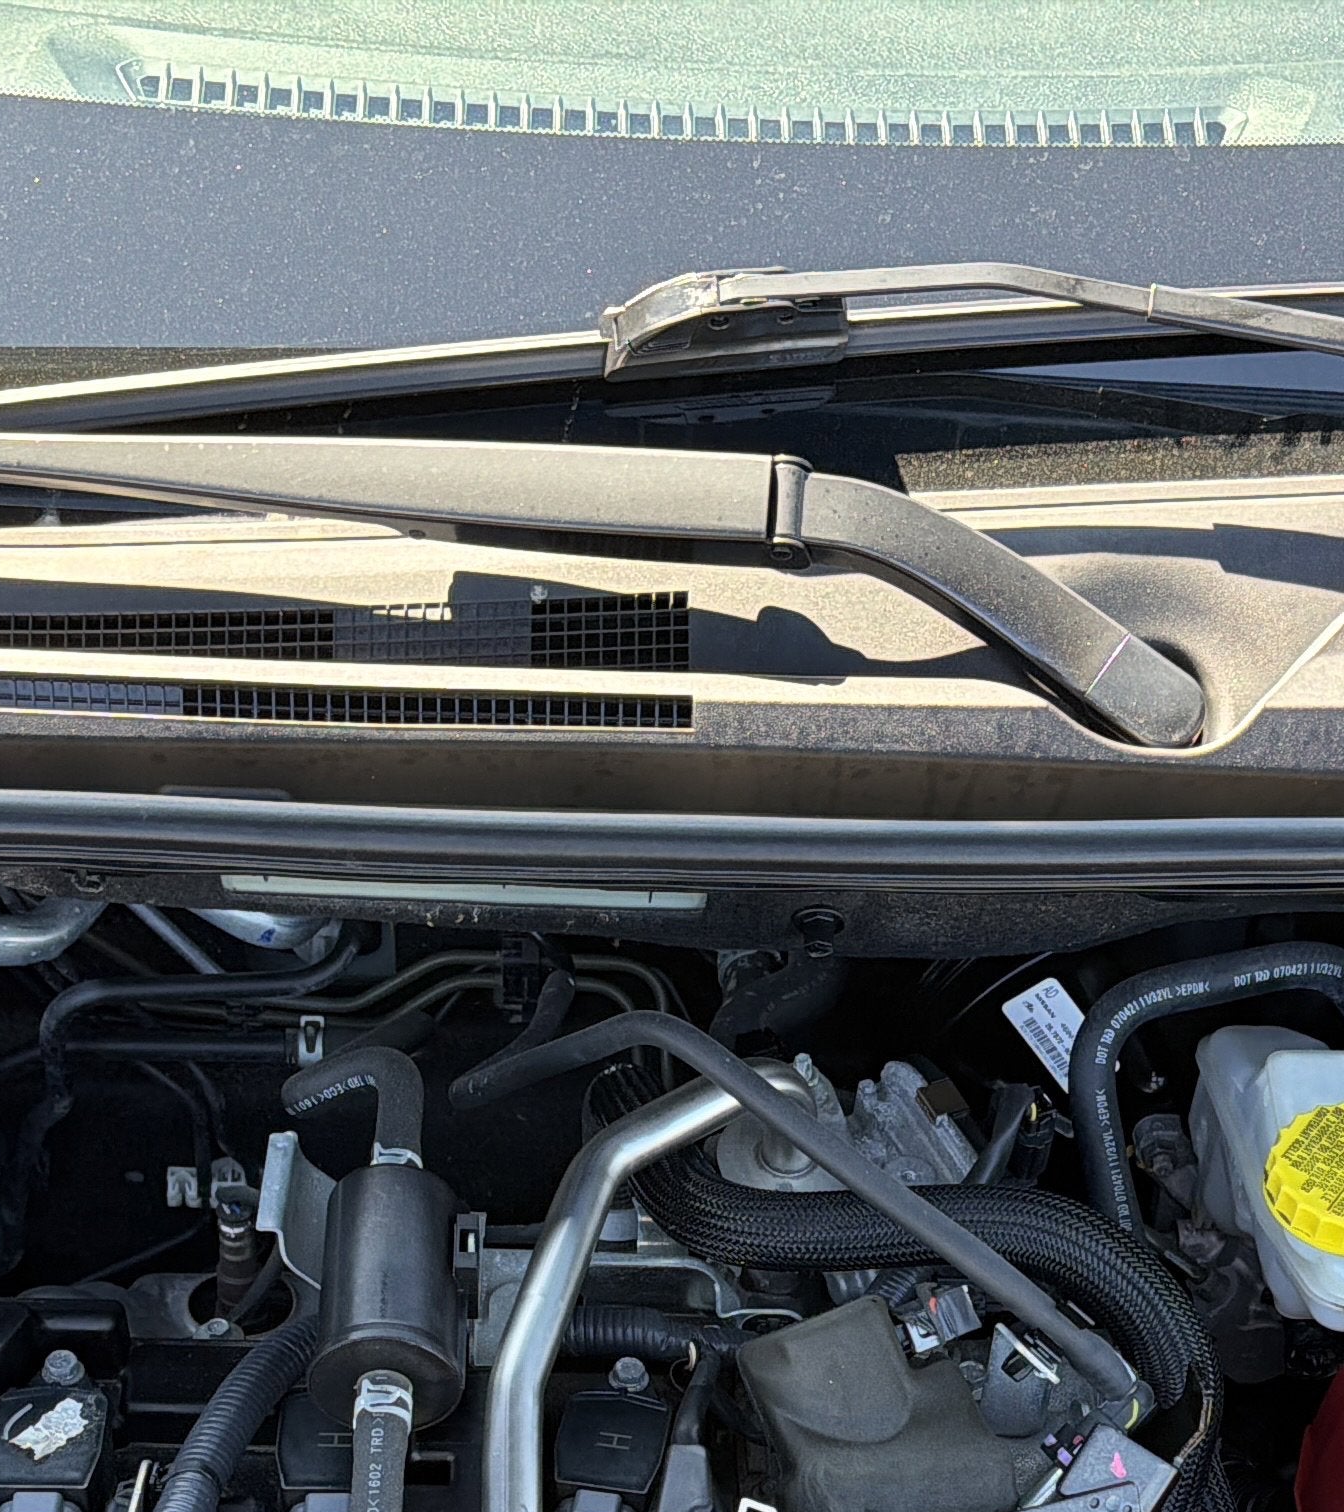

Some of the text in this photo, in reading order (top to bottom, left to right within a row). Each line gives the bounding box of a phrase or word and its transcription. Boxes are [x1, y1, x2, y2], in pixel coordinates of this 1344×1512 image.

[1095, 1041, 1109, 1065] DOT
[1233, 973, 1252, 988] DOT
[1273, 962, 1307, 979] 070421
